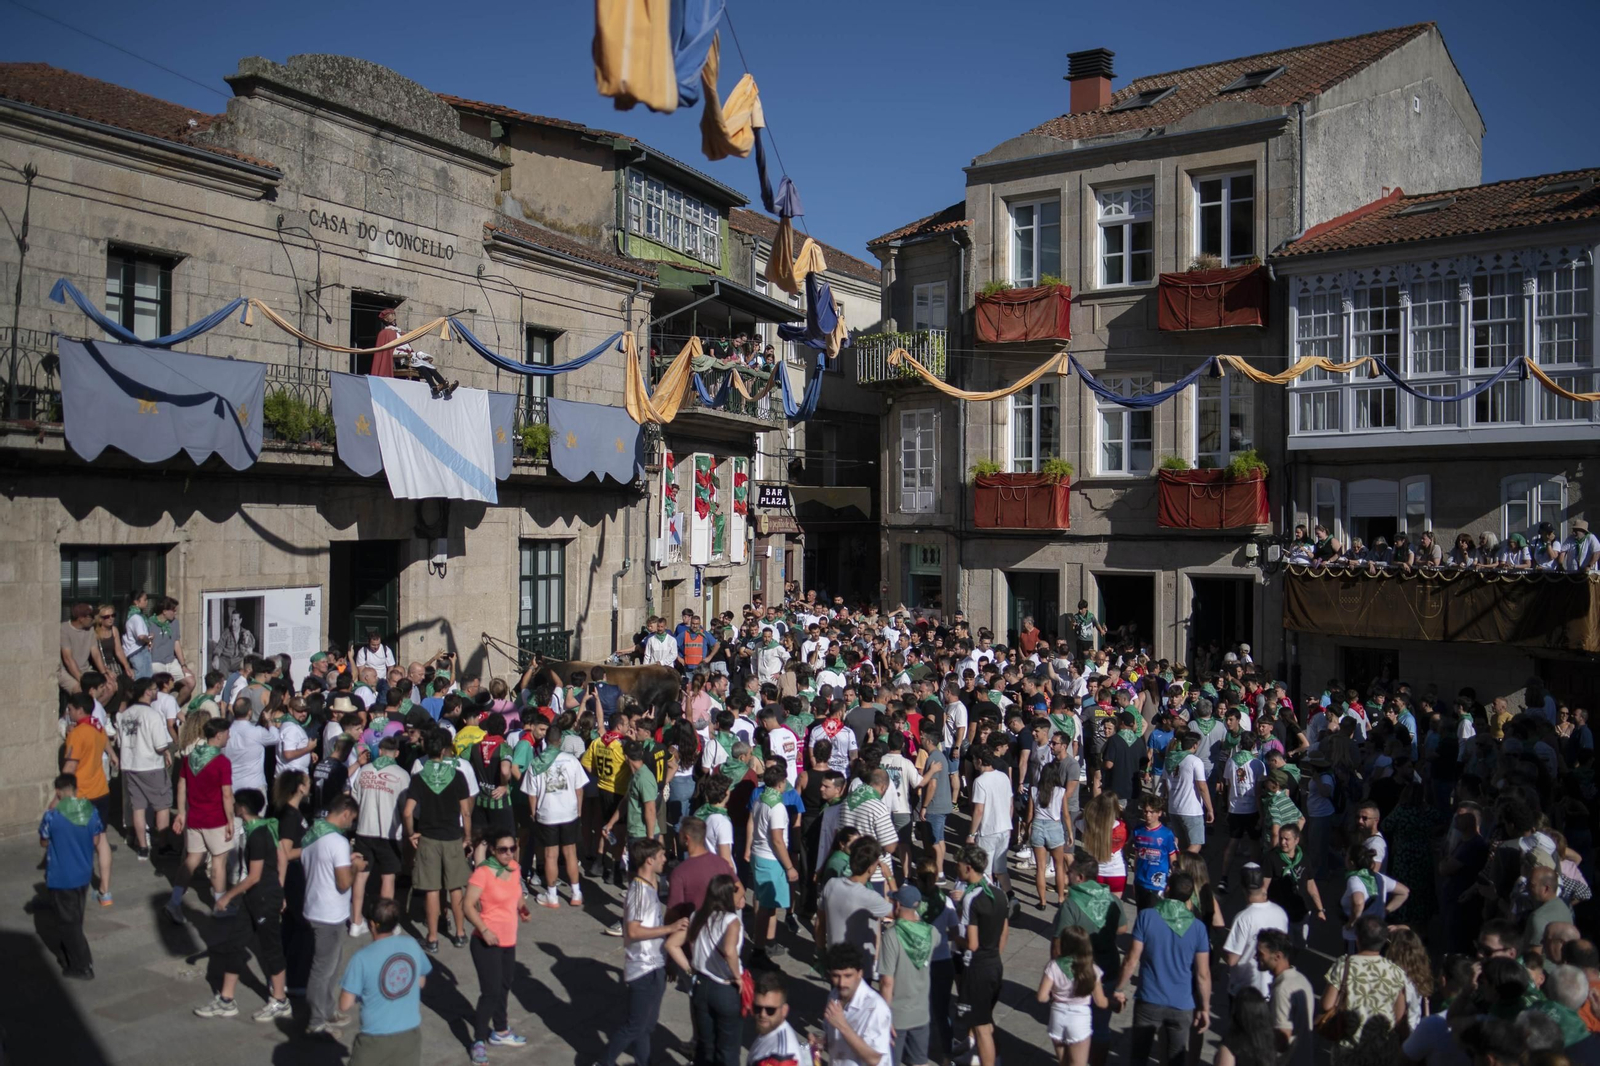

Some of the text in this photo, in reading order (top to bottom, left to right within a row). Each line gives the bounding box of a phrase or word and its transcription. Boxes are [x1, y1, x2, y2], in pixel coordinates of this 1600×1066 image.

[309, 209, 454, 260] CASA DO CONCELLO
[765, 488, 783, 496] BAR
[760, 497, 787, 505] PLAZA
